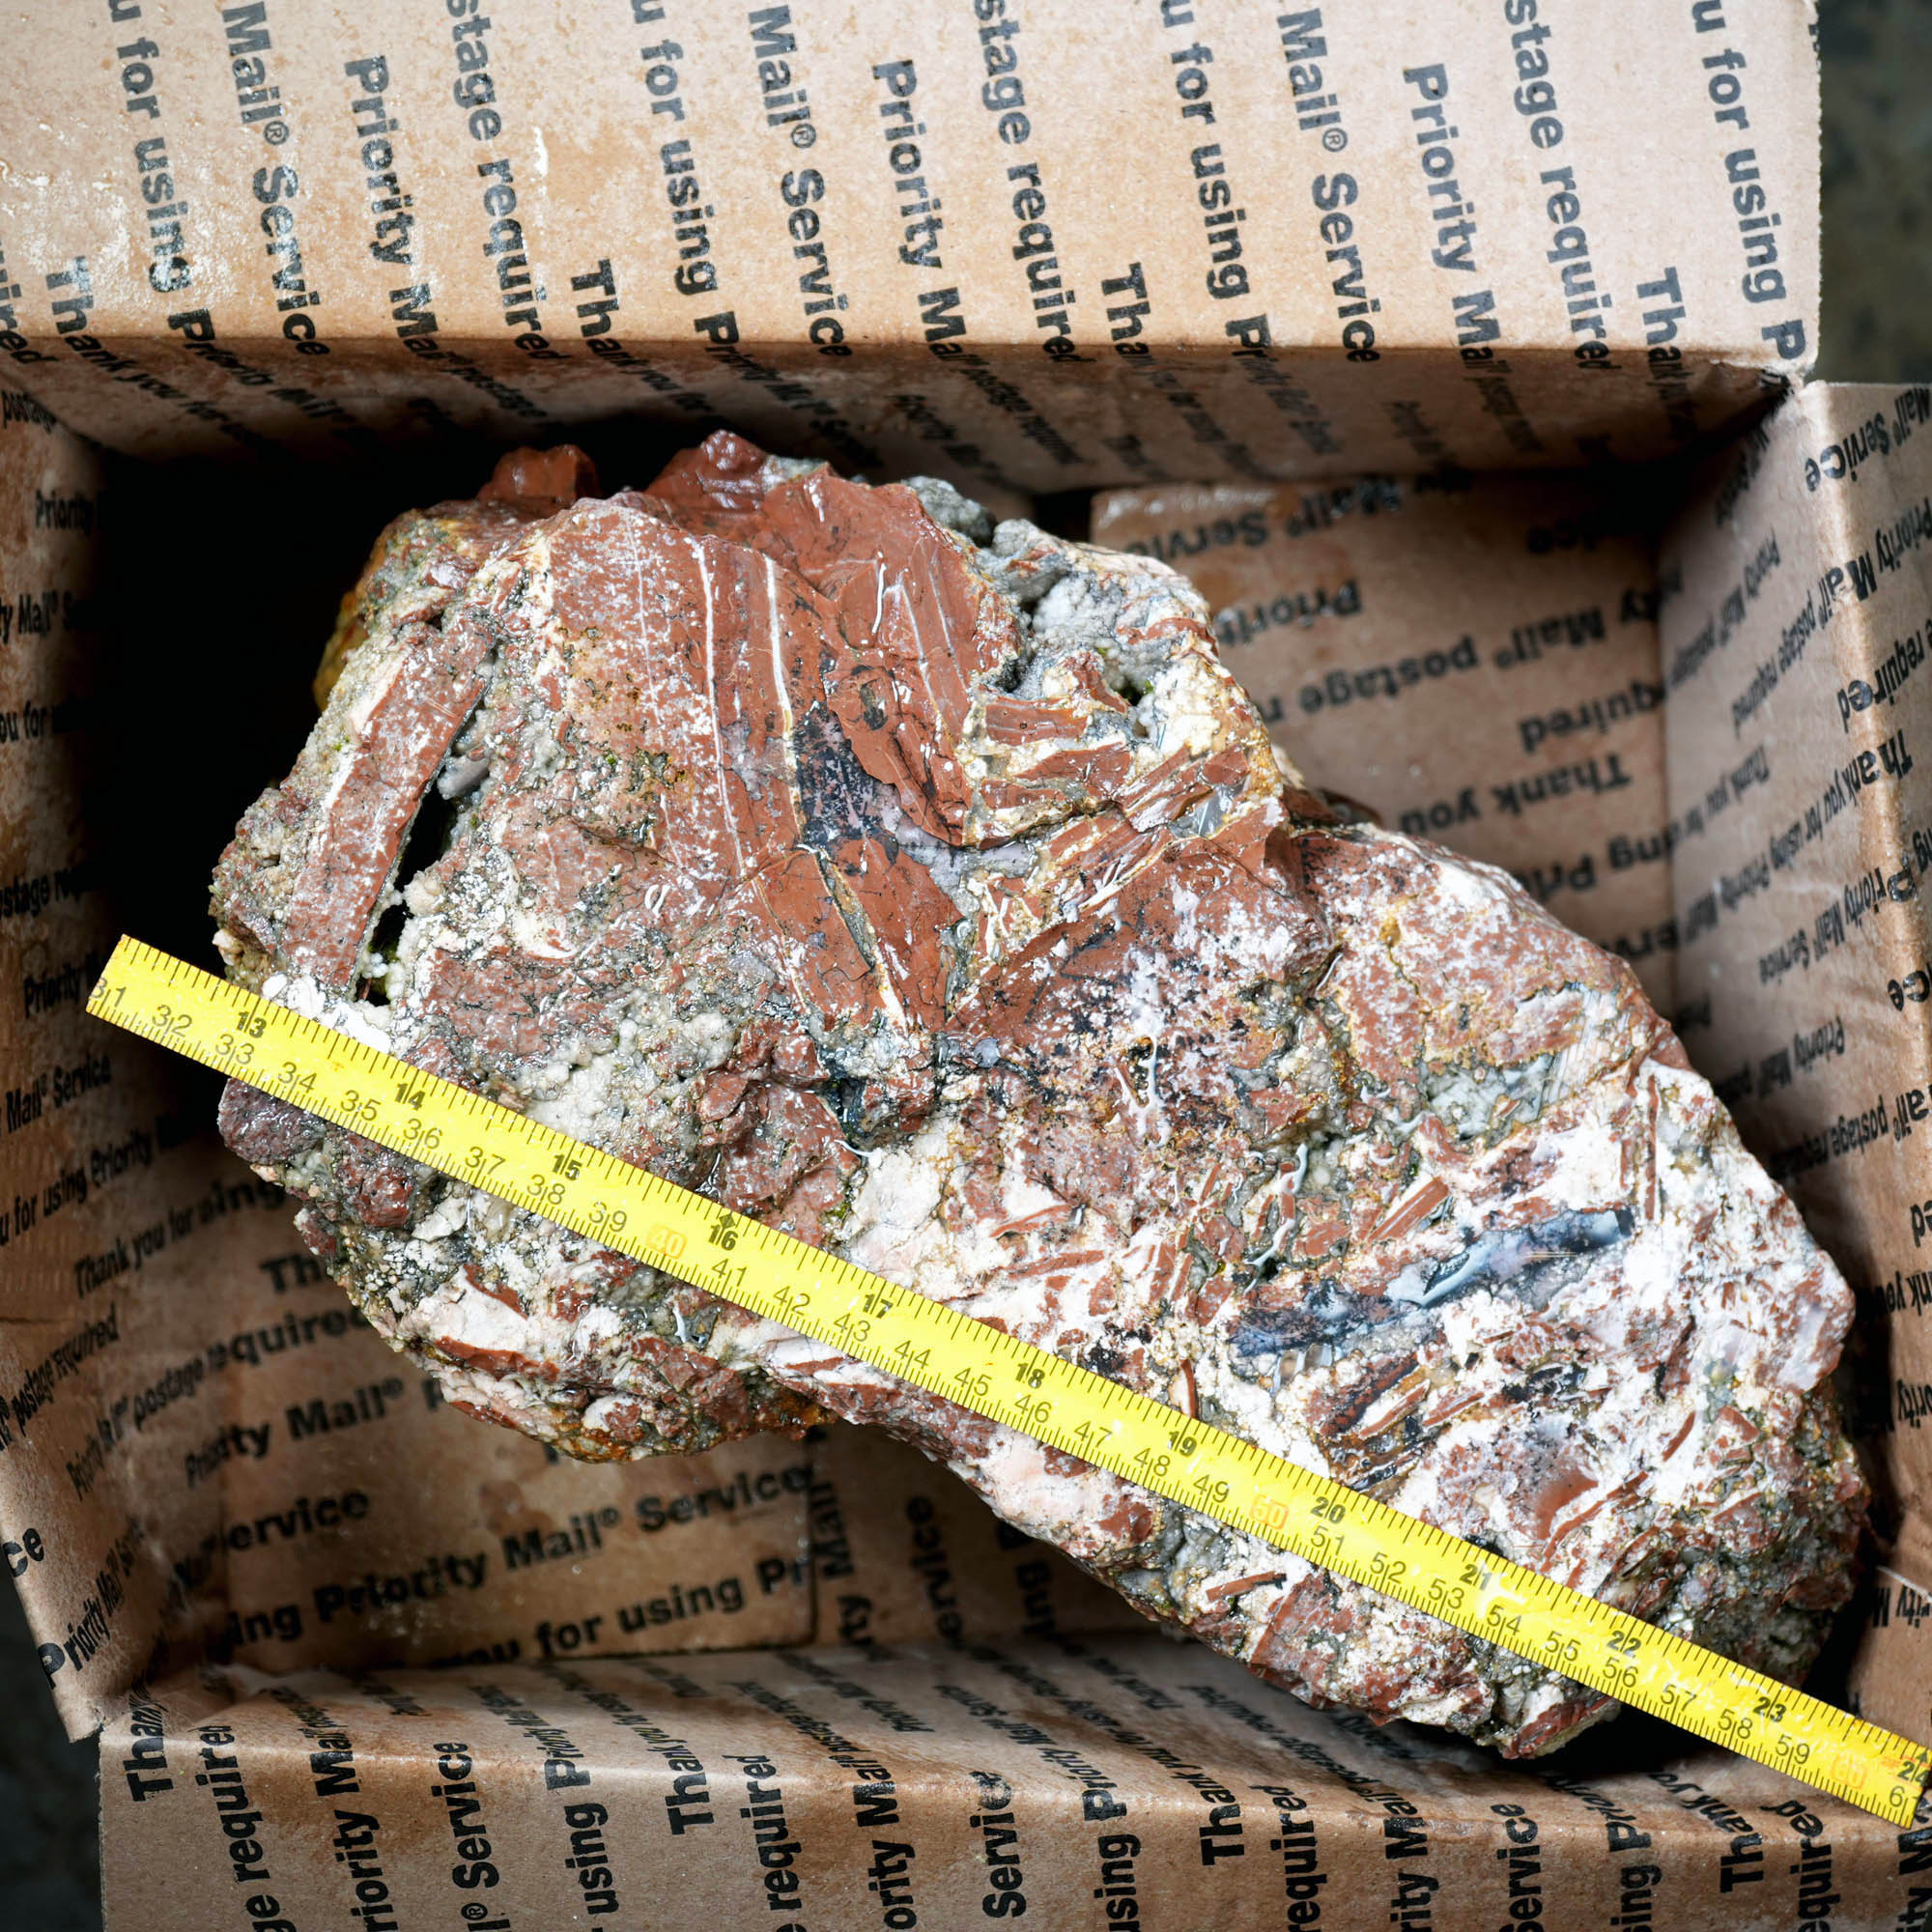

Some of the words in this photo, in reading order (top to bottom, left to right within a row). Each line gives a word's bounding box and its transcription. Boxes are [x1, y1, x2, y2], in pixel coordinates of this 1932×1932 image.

[117, 37, 160, 120] for
[640, 39, 685, 122] for
[1171, 43, 1216, 125] for
[1701, 47, 1750, 130] for
[344, 55, 415, 265] Priority
[871, 59, 944, 270] Priority
[975, 0, 1032, 146] stage
[1007, 162, 1097, 363] required
[1403, 63, 1477, 272] Priority
[1504, 0, 1564, 150] stage
[1540, 165, 1623, 371] required
[134, 137, 192, 293] using
[660, 139, 718, 296] using
[1190, 143, 1251, 301] using
[1723, 148, 1788, 304] using
[252, 165, 330, 357] Service
[477, 158, 572, 360] required
[781, 169, 853, 357] Service
[1312, 172, 1381, 364] Service
[46, 256, 137, 372] Thank
[570, 258, 650, 366] Thank
[1804, 412, 1890, 493] Service
[1875, 497, 1932, 574] Priority
[1778, 590, 1818, 674] postage
[1298, 635, 1479, 716] postage
[1837, 631, 1925, 734] required
[23, 700, 47, 739] for
[1492, 754, 1631, 817] Thank
[1823, 770, 1846, 823] you
[1842, 729, 1914, 807] Thank
[1397, 787, 1481, 837] you
[1770, 821, 1804, 870] using
[1804, 801, 1824, 841] for
[1844, 857, 1918, 927] Priority
[24, 963, 80, 1018] Priority
[1758, 928, 1810, 984] Service
[53, 1052, 112, 1109] Service
[1793, 1016, 1845, 1071] Priority
[1830, 1094, 1889, 1157] postage
[14, 1197, 37, 1236] for
[43, 1166, 88, 1218] using
[74, 1236, 130, 1299] Thank
[131, 1226, 166, 1272] you
[168, 1207, 194, 1243] for
[133, 1359, 206, 1432] postage
[151, 1005, 193, 1037] 32
[215, 1034, 254, 1065] 33
[277, 1062, 318, 1094] 34
[340, 1090, 381, 1121] 35
[403, 1118, 443, 1150] 36
[465, 1146, 505, 1176] 37
[526, 1174, 566, 1206] 38
[589, 1201, 627, 1233] 39
[648, 1222, 687, 1258] 40
[711, 1258, 749, 1287] 41
[773, 1286, 810, 1316] 42
[834, 1313, 871, 1343] 43
[894, 1340, 931, 1370] 44
[953, 1367, 992, 1397] 45
[1015, 1394, 1052, 1423] 46
[1074, 1421, 1113, 1448] 47
[1133, 1447, 1171, 1477] 48
[1193, 1474, 1230, 1503] 49
[1311, 1525, 1346, 1555] 51
[1370, 1551, 1406, 1583] 52
[1428, 1578, 1464, 1610] 53
[1487, 1605, 1522, 1635] 54
[1545, 1631, 1581, 1662] 55
[1602, 1657, 1638, 1688] 56
[1661, 1683, 1697, 1712] 57
[1718, 1709, 1753, 1740] 58
[1776, 1734, 1810, 1765] 59
[1889, 1785, 1918, 1808] 6
[238, 1010, 268, 1039] 13
[395, 1083, 425, 1111] 14
[552, 1154, 583, 1181] 15
[709, 1224, 739, 1251] 16
[863, 1293, 894, 1319] 17
[1015, 1362, 1045, 1389] 18
[1168, 1430, 1197, 1457] 19
[1311, 1495, 1346, 1524] 20
[1460, 1563, 1492, 1590] 21
[1606, 1631, 1641, 1658] 22
[1752, 1696, 1787, 1722] 23
[1897, 1761, 1929, 1783] 24
[224, 1492, 370, 1551] ervice
[634, 1463, 813, 1532] Service
[313, 1551, 486, 1622] Priority
[906, 1496, 965, 1639] ervice
[37, 1596, 111, 1690] Priority
[536, 1616, 605, 1657] for
[615, 1577, 745, 1634] using
[123, 1701, 173, 1802] Thank
[523, 1727, 590, 1790] Priority
[631, 1726, 688, 1746] you
[1105, 1729, 1153, 1746] for
[1137, 1747, 1204, 1770] you
[1273, 1737, 1381, 1785] postage
[187, 1725, 270, 1883] required
[431, 1742, 499, 1889] Service
[646, 1745, 715, 1835] Thank
[1037, 1747, 1127, 1822] Priority
[1171, 1772, 1244, 1866] Thank
[564, 1803, 619, 1915] using
[723, 1754, 802, 1910] required
[970, 1771, 1027, 1918] Service
[1683, 1795, 1765, 1893] Thank
